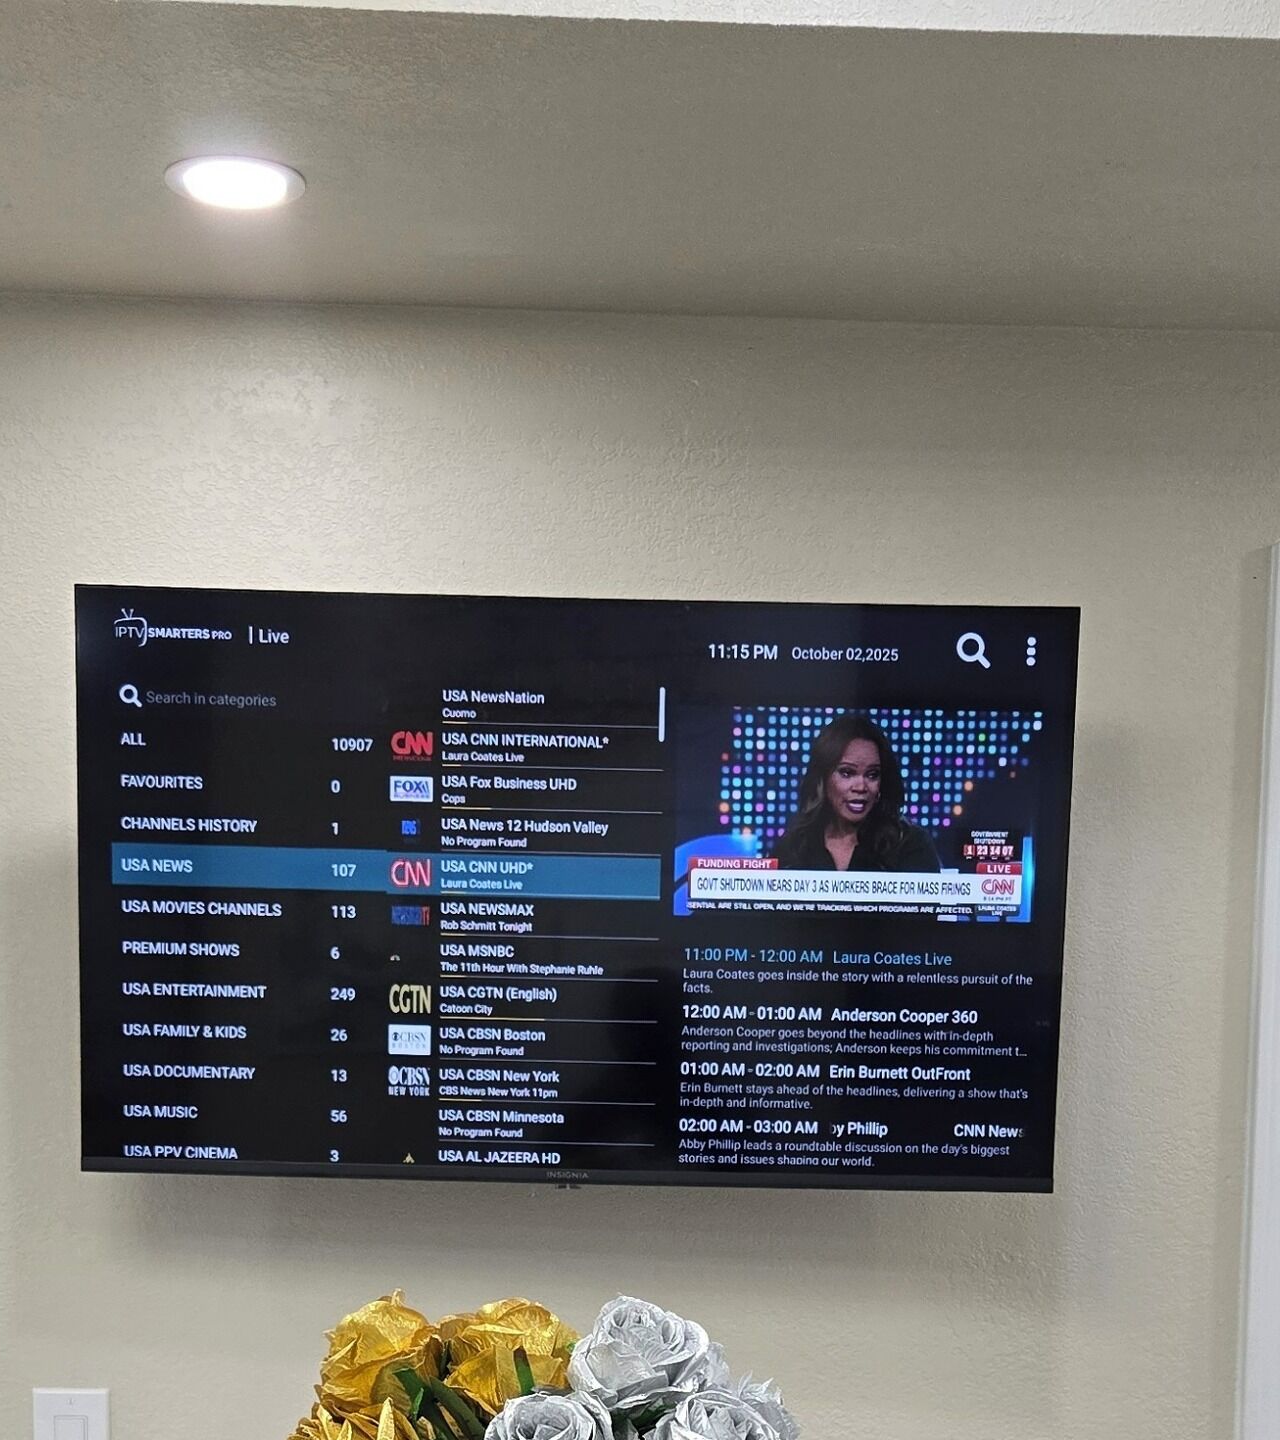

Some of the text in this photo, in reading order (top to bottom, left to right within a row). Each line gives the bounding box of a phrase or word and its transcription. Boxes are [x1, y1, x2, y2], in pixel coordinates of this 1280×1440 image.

[115, 626, 233, 641] IPTV SMARTERS PRO
[258, 628, 289, 643] Live
[708, 643, 778, 660] 11:15 PM
[791, 646, 898, 662] October 02,2025
[146, 690, 276, 708] Search in categories
[442, 689, 544, 704] USA NewsNation
[441, 707, 476, 718] Cuomo
[120, 732, 146, 746] ALL
[331, 737, 373, 751] 10907
[390, 730, 434, 756] CNN
[441, 732, 468, 745] USA
[470, 732, 498, 746] CNN
[120, 773, 203, 789] FAVOURITES
[330, 779, 340, 793] 0
[441, 775, 577, 790] USA Fox Business UHD
[441, 793, 465, 805] Cops
[120, 816, 257, 832] CHANNELS HISTORY
[331, 822, 338, 835] 1
[441, 817, 608, 834] USA News 12 Hudson Valley
[120, 857, 193, 873] USA NEWS
[331, 863, 356, 877] 107
[440, 859, 467, 872] USA
[468, 860, 497, 873] CNN
[697, 858, 772, 869] FUNDING FIGHT
[986, 864, 1012, 874] LIVE
[391, 858, 431, 887] CNN
[697, 876, 718, 890] GOVT
[719, 877, 763, 891] SHUTDOWN
[766, 878, 792, 892] NEARS
[794, 879, 809, 892] DAY
[811, 879, 816, 893] 3
[818, 879, 829, 893] AS
[831, 879, 869, 894] WORKERS
[871, 880, 897, 894] BRACE
[899, 881, 915, 894] FOR
[917, 881, 939, 895] MASS
[981, 878, 1015, 895] CNN
[121, 899, 282, 916] USA MOVIES CHANNELS
[331, 905, 356, 918] 113
[440, 902, 534, 916] USA NEWSMAX
[122, 940, 240, 956] PREMIUM SHOWS
[330, 946, 340, 959] 6
[440, 943, 514, 957] USA MSNBC
[684, 947, 823, 963] 11:00 PM 12:00 AM
[833, 950, 952, 965] Laura Coates Live
[439, 961, 604, 975] The 11th Hour With Stephanie Ruhle
[122, 982, 267, 998] USA ENTERTAINMENT
[330, 987, 355, 1001] 249
[439, 985, 557, 1001] USA CGTN (English)
[389, 984, 432, 1015] CGTN
[682, 1004, 822, 1020] 12:00 AM 01:00 AM
[830, 1007, 978, 1025] Anderson Cooper 360
[122, 1023, 246, 1038] USA FAMILY & KIDS
[330, 1028, 347, 1041] 26
[439, 1027, 545, 1041] USA CBSN Boston
[123, 1063, 255, 1079] USA DOCUMENTARY
[331, 1068, 347, 1082] 13
[439, 1068, 559, 1082] USA CBSN New York
[680, 1061, 820, 1077] 01:00 AM 02:00 AM
[829, 1064, 971, 1080] Erin Burnett OutFront
[388, 1085, 430, 1097] NEW YORK
[679, 1096, 812, 1109] in-depth and informative.
[123, 1104, 198, 1118] USA MUSIC
[330, 1109, 347, 1122] 56
[438, 1109, 564, 1123] USA CBSN Minnesota
[679, 1118, 818, 1134] 02:00 AM 03:00 AM
[847, 1121, 888, 1138] Phillip
[953, 1123, 985, 1137] CNN
[124, 1144, 238, 1159] USA PPV CINEMA
[329, 1149, 339, 1162] 3
[438, 1149, 560, 1164] USA AL JAZEERA HD
